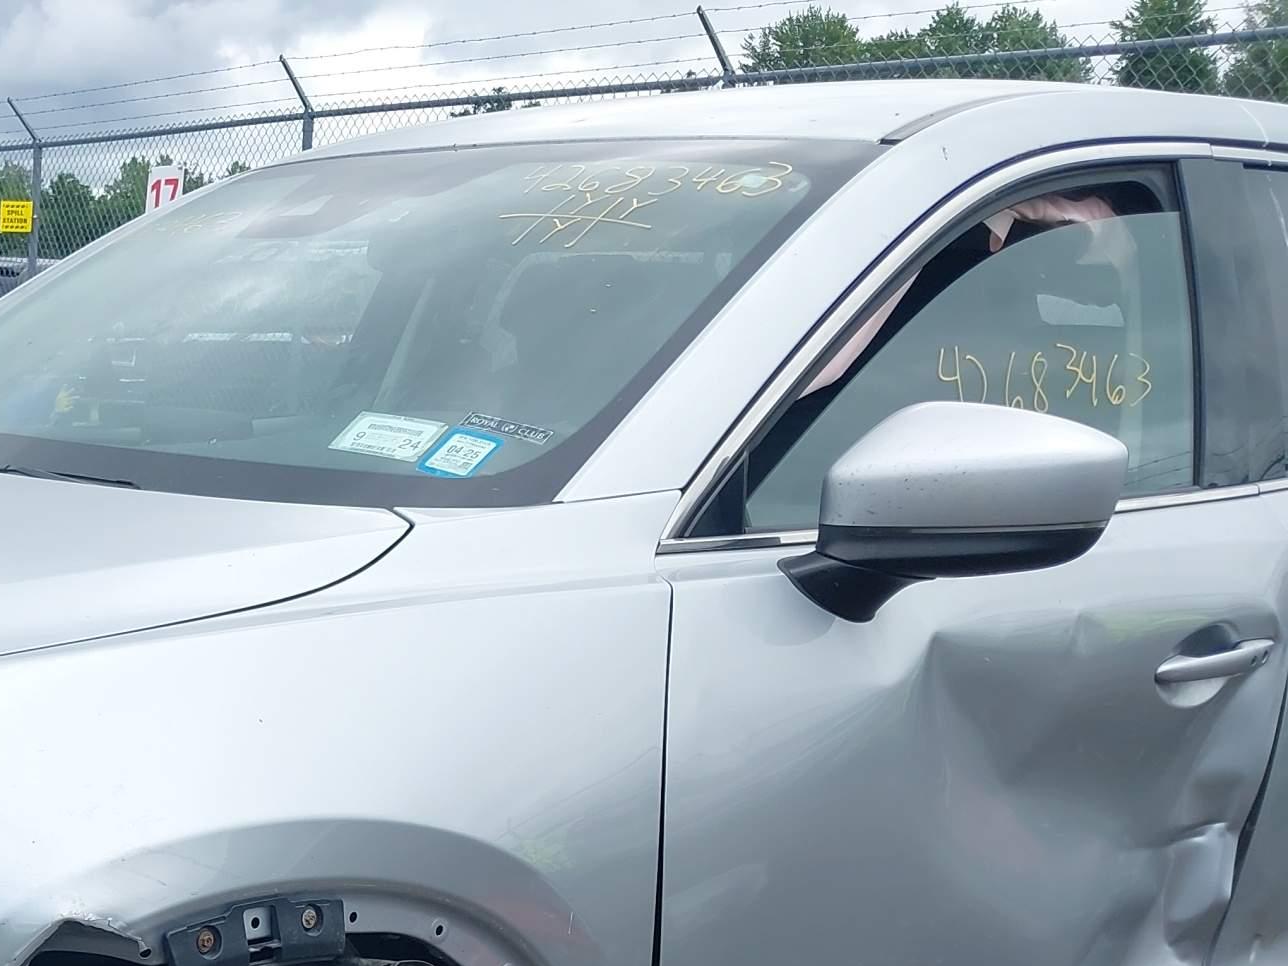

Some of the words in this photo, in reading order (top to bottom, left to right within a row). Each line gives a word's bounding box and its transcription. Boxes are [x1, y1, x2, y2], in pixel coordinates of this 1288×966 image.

[524, 161, 793, 197] 42683463
[150, 178, 179, 209] 17
[470, 416, 499, 428] ROYAL
[518, 428, 545, 440] CLUB
[398, 438, 422, 451] 24
